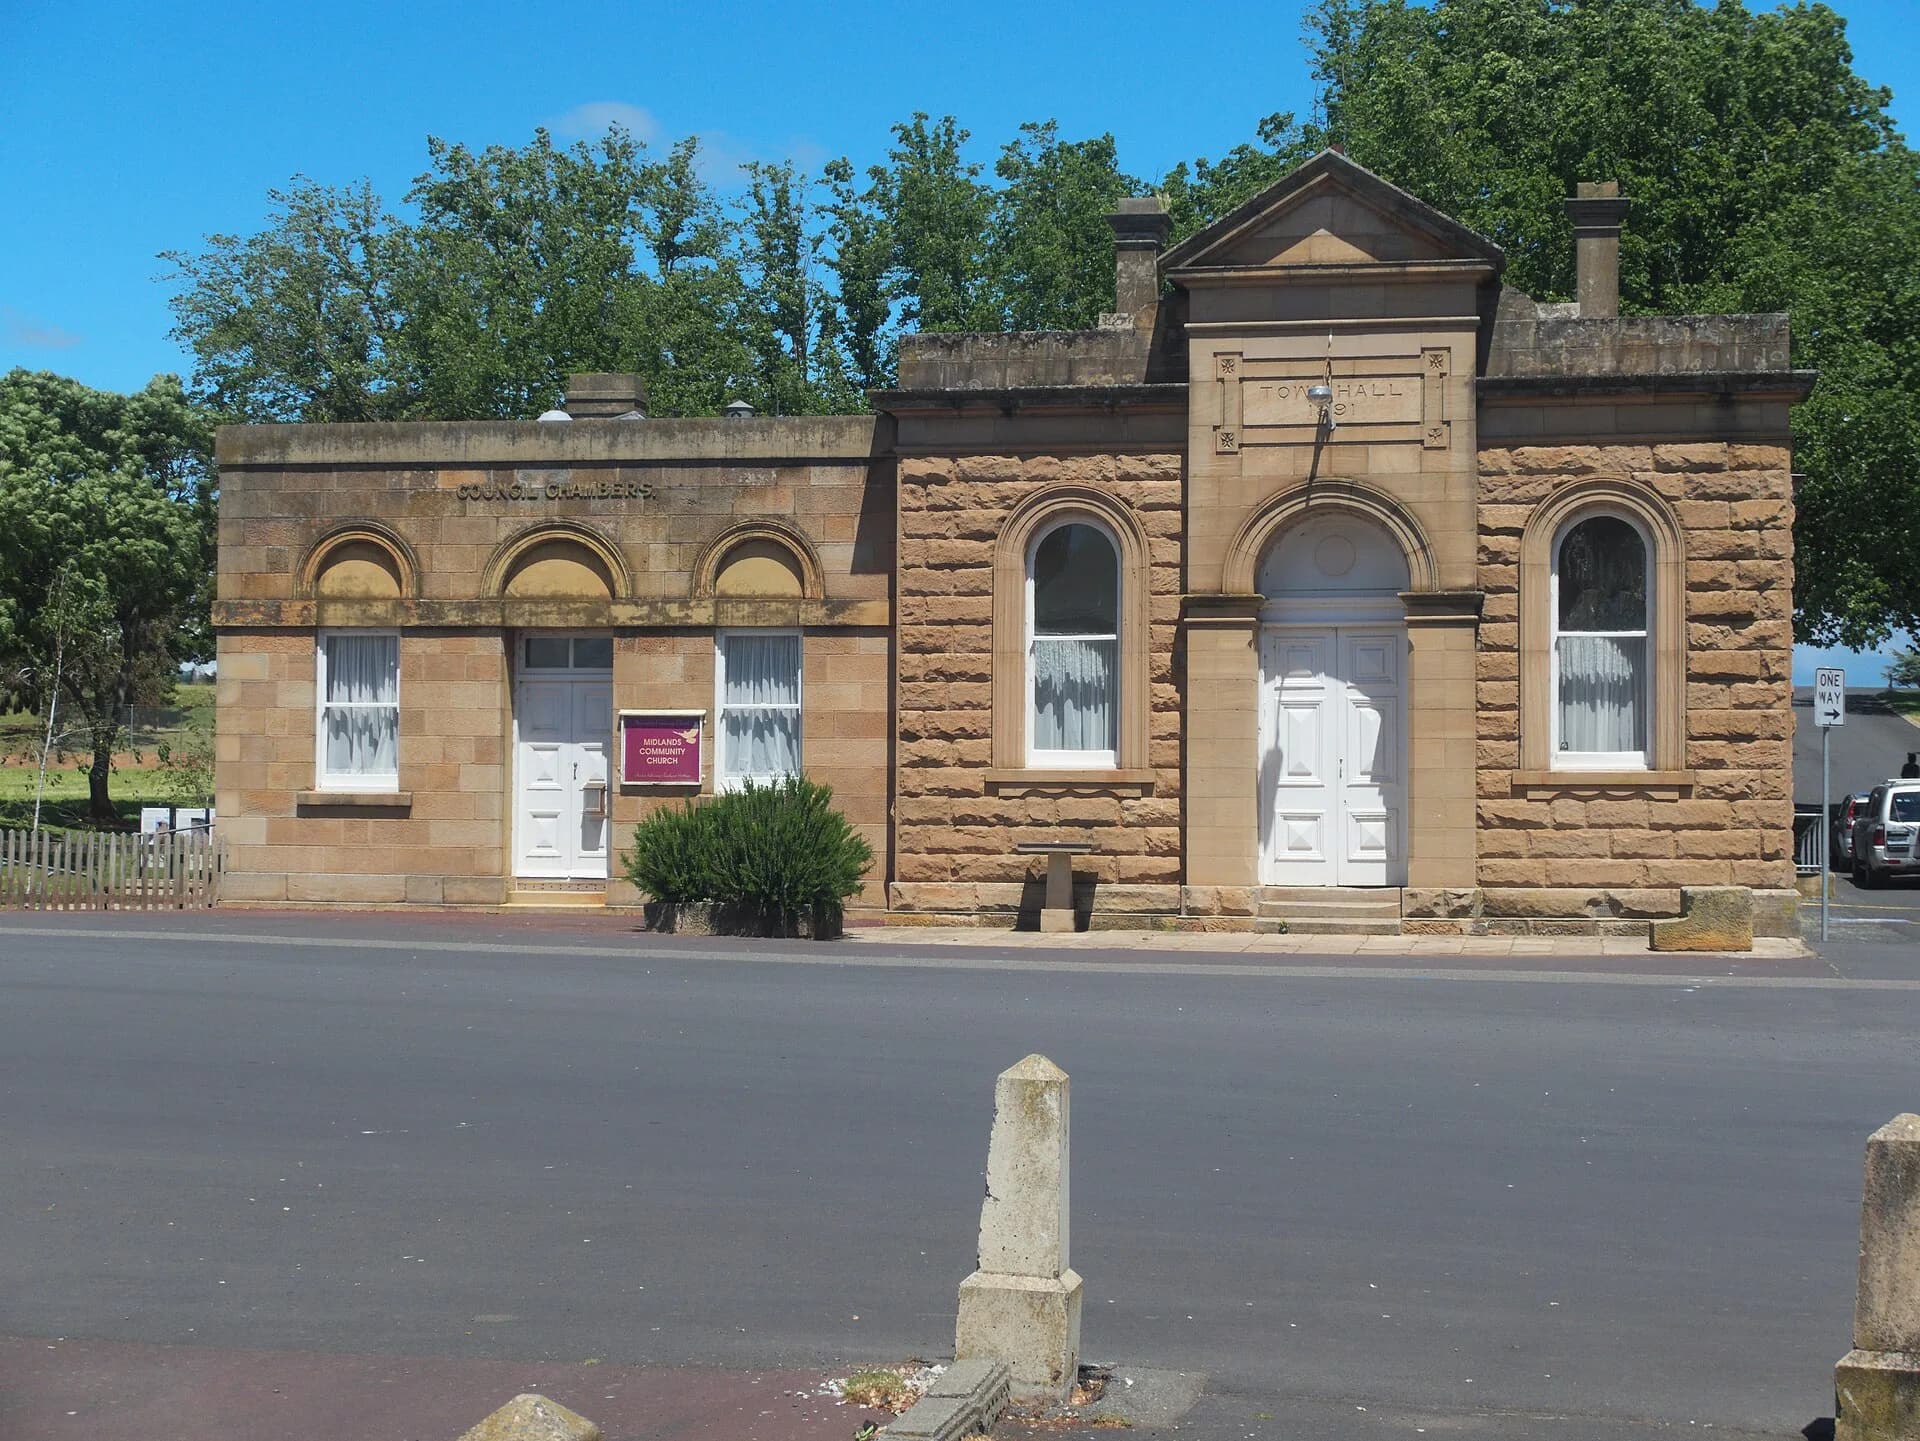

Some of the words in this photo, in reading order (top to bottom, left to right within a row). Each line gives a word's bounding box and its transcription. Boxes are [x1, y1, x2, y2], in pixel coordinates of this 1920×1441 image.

[1260, 386, 1319, 400] TOW
[1337, 384, 1402, 397] HALL
[456, 484, 537, 500] COUNCIL
[1820, 673, 1840, 687] ONE
[1819, 691, 1841, 704] WAY
[643, 738, 682, 746] MIDLANDS
[646, 757, 678, 765] CHURCH
